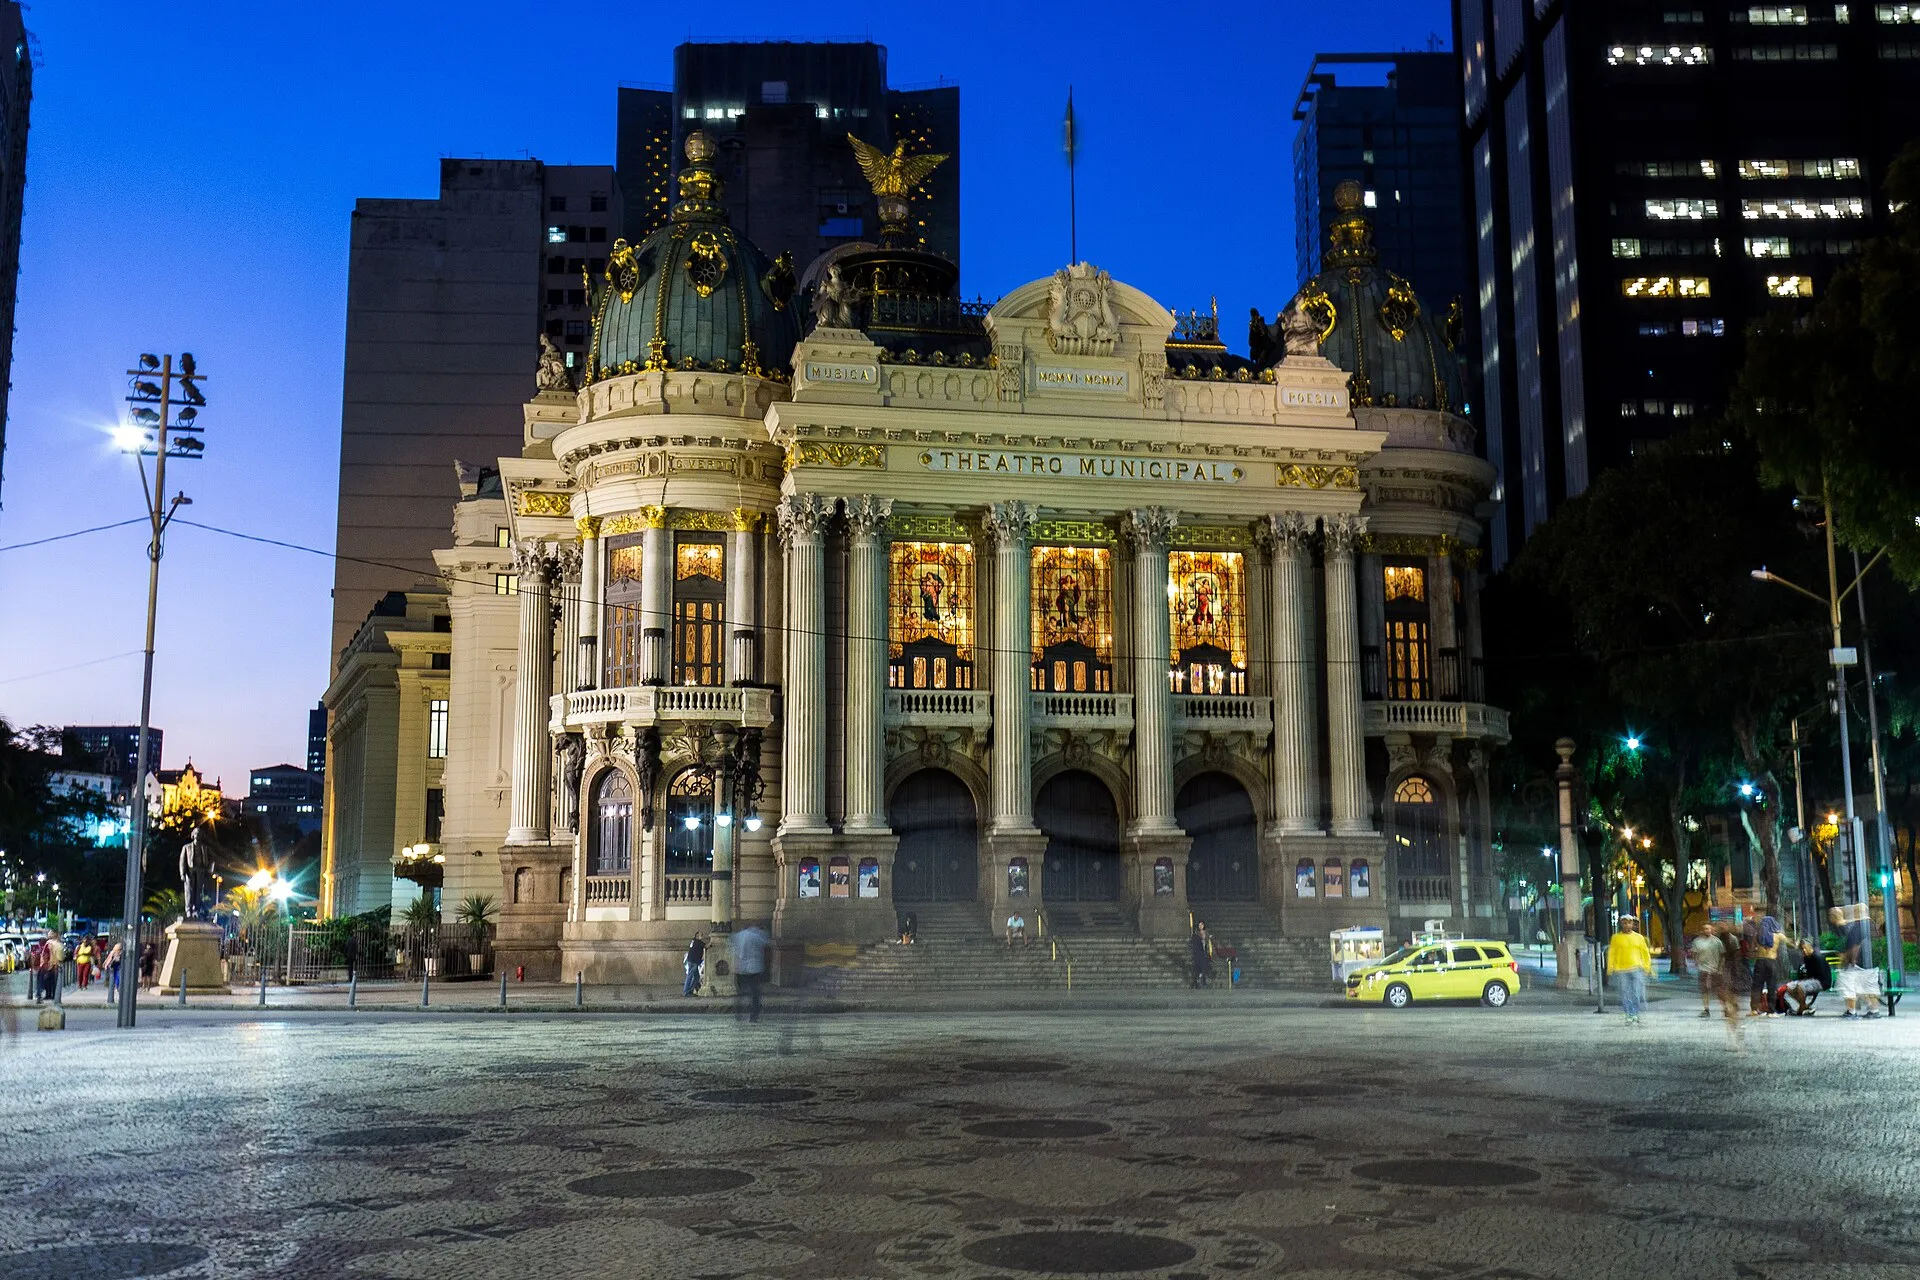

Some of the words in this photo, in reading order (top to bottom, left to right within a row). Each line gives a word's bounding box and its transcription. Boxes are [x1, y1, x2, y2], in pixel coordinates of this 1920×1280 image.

[812, 367, 869, 381] MUSICA
[1289, 392, 1339, 405] POESIA
[939, 451, 1062, 473] THEATRO
[1079, 457, 1225, 481] MUNICIPAL
